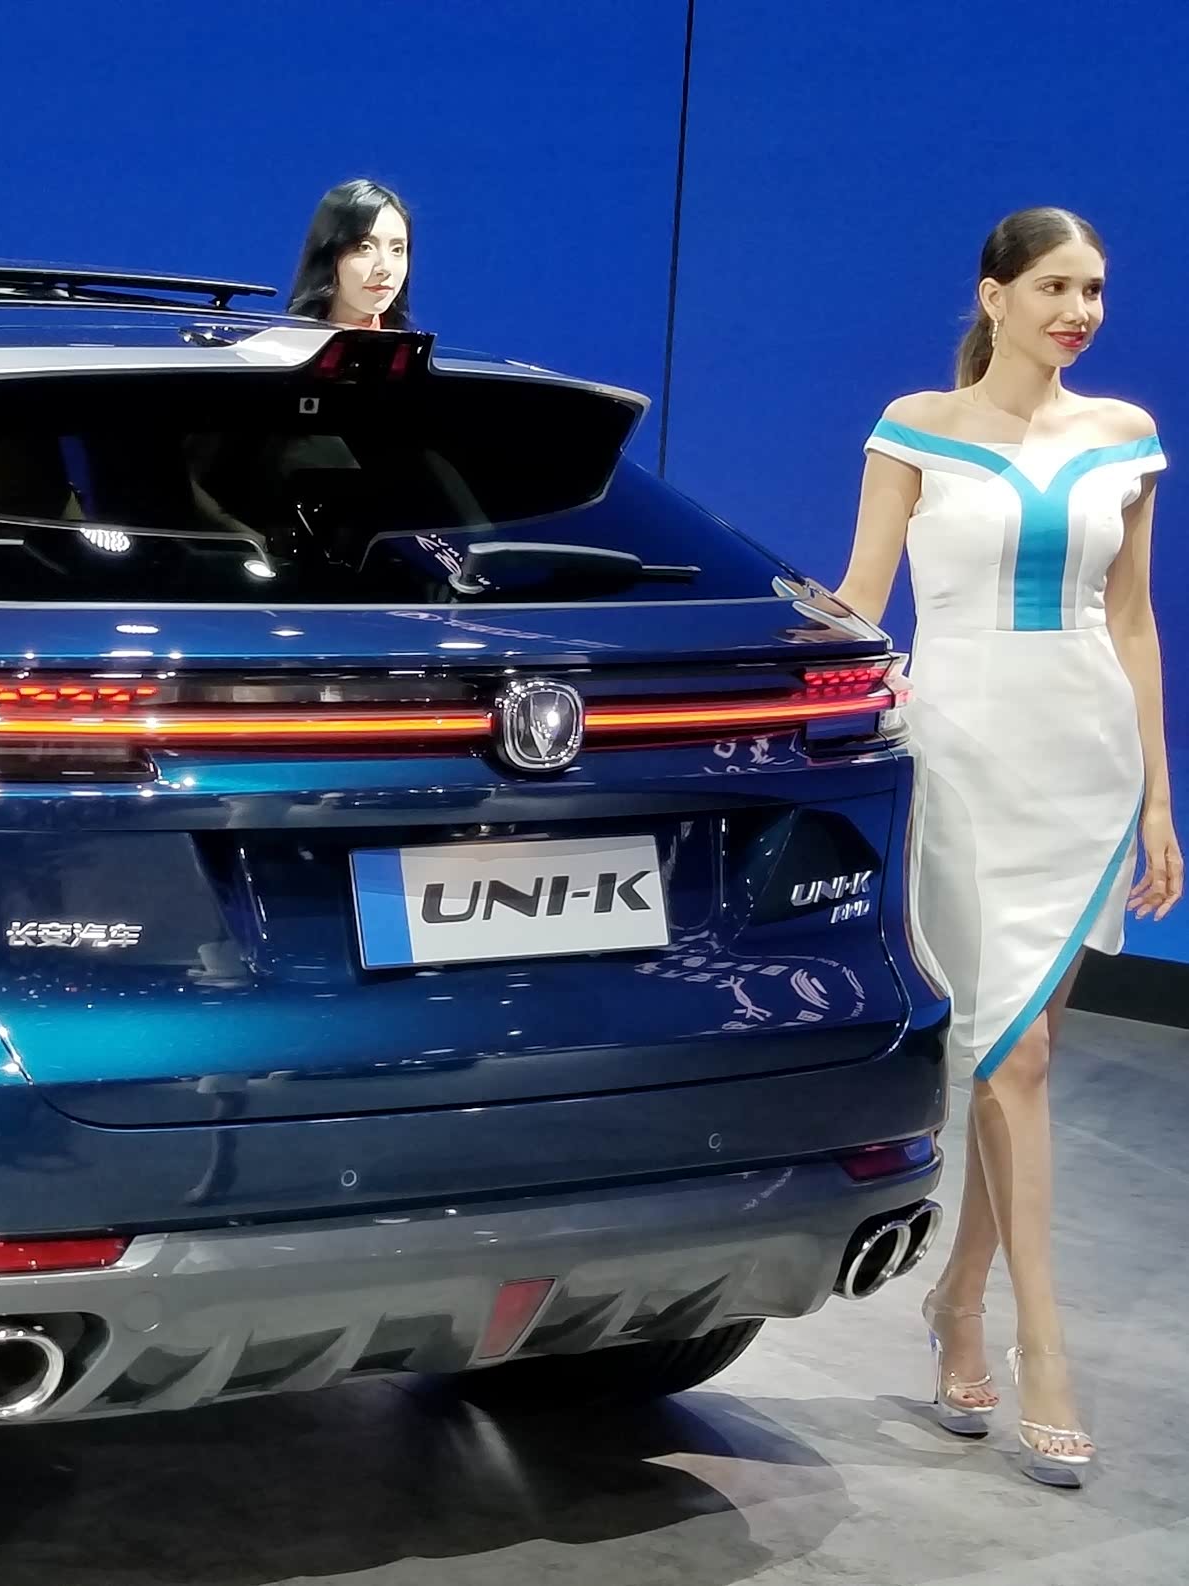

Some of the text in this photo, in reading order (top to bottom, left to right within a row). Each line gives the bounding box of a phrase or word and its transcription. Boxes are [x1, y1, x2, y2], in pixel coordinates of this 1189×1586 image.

[422, 870, 651, 924] UNI-K
[790, 870, 873, 907] UNI-K
[5, 922, 143, 948] 长安汽车
